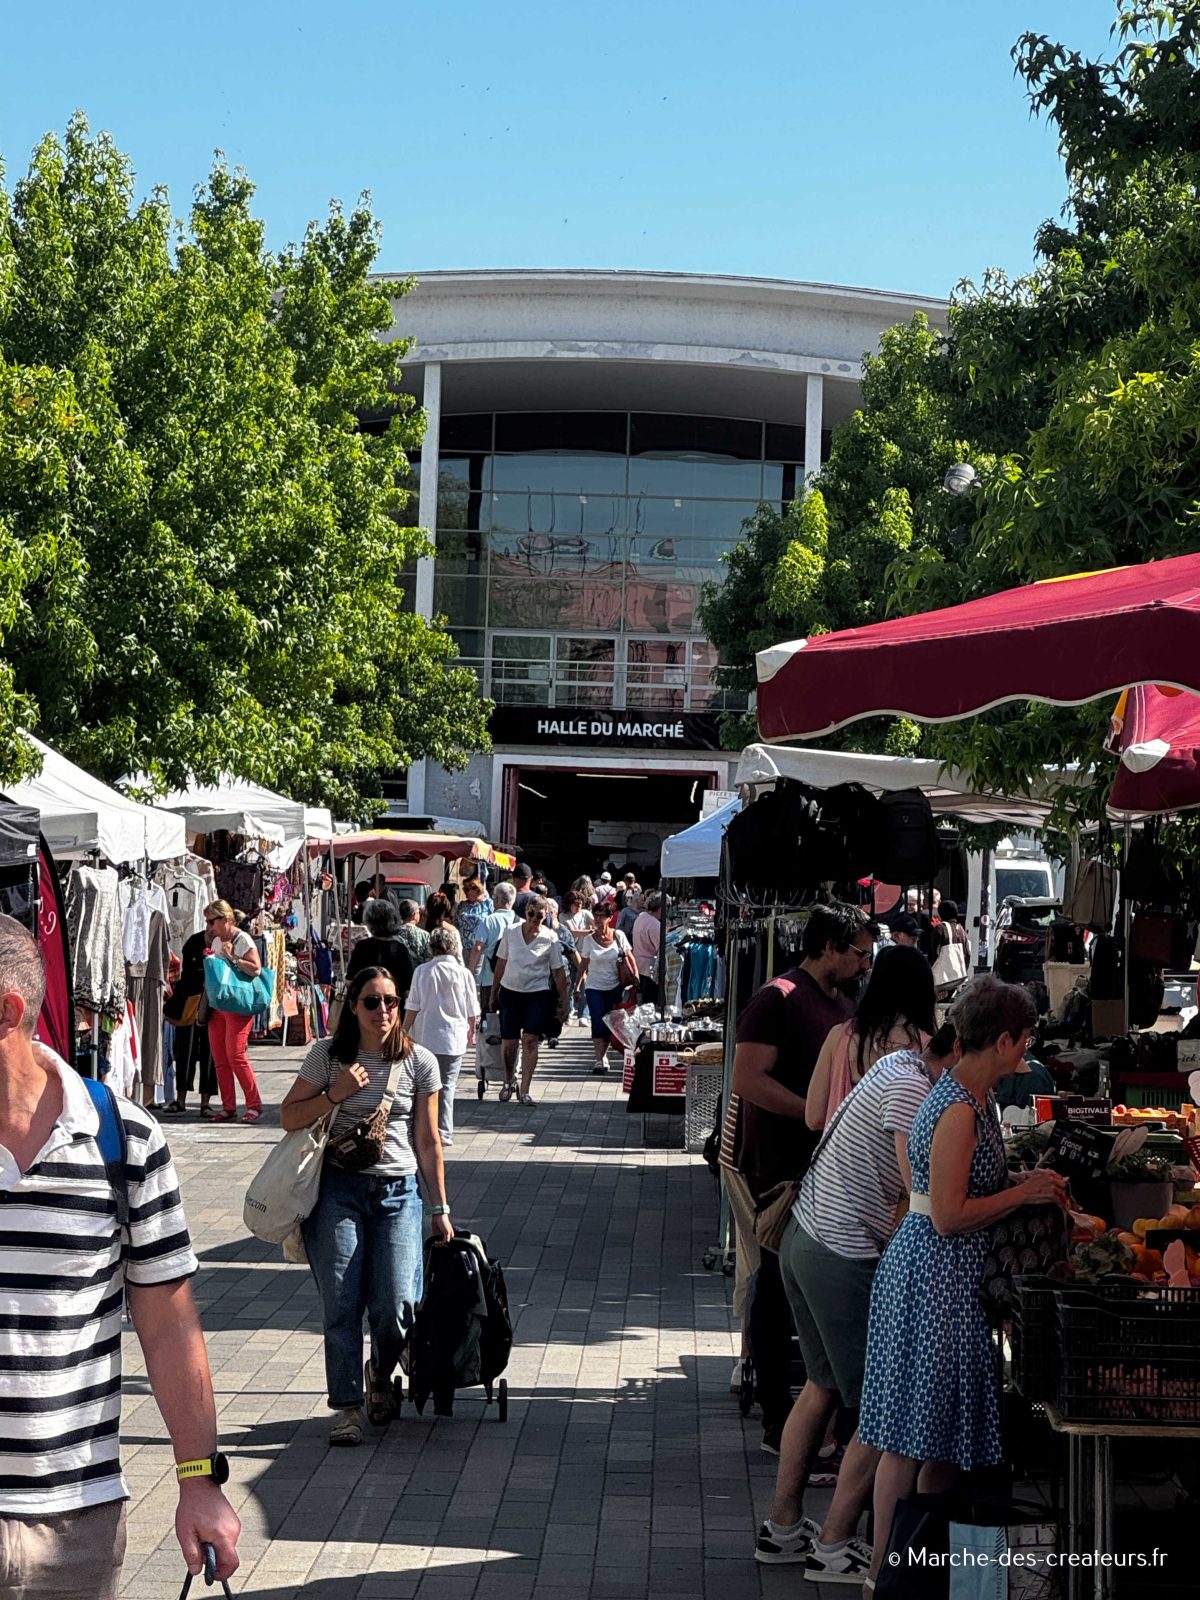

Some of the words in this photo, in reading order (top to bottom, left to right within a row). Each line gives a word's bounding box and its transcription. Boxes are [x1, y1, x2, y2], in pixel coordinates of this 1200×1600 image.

[537, 720, 587, 735] HALLE
[591, 722, 613, 736] DU
[617, 720, 684, 738] MARCHÉ
[1061, 1136, 1083, 1152] France
